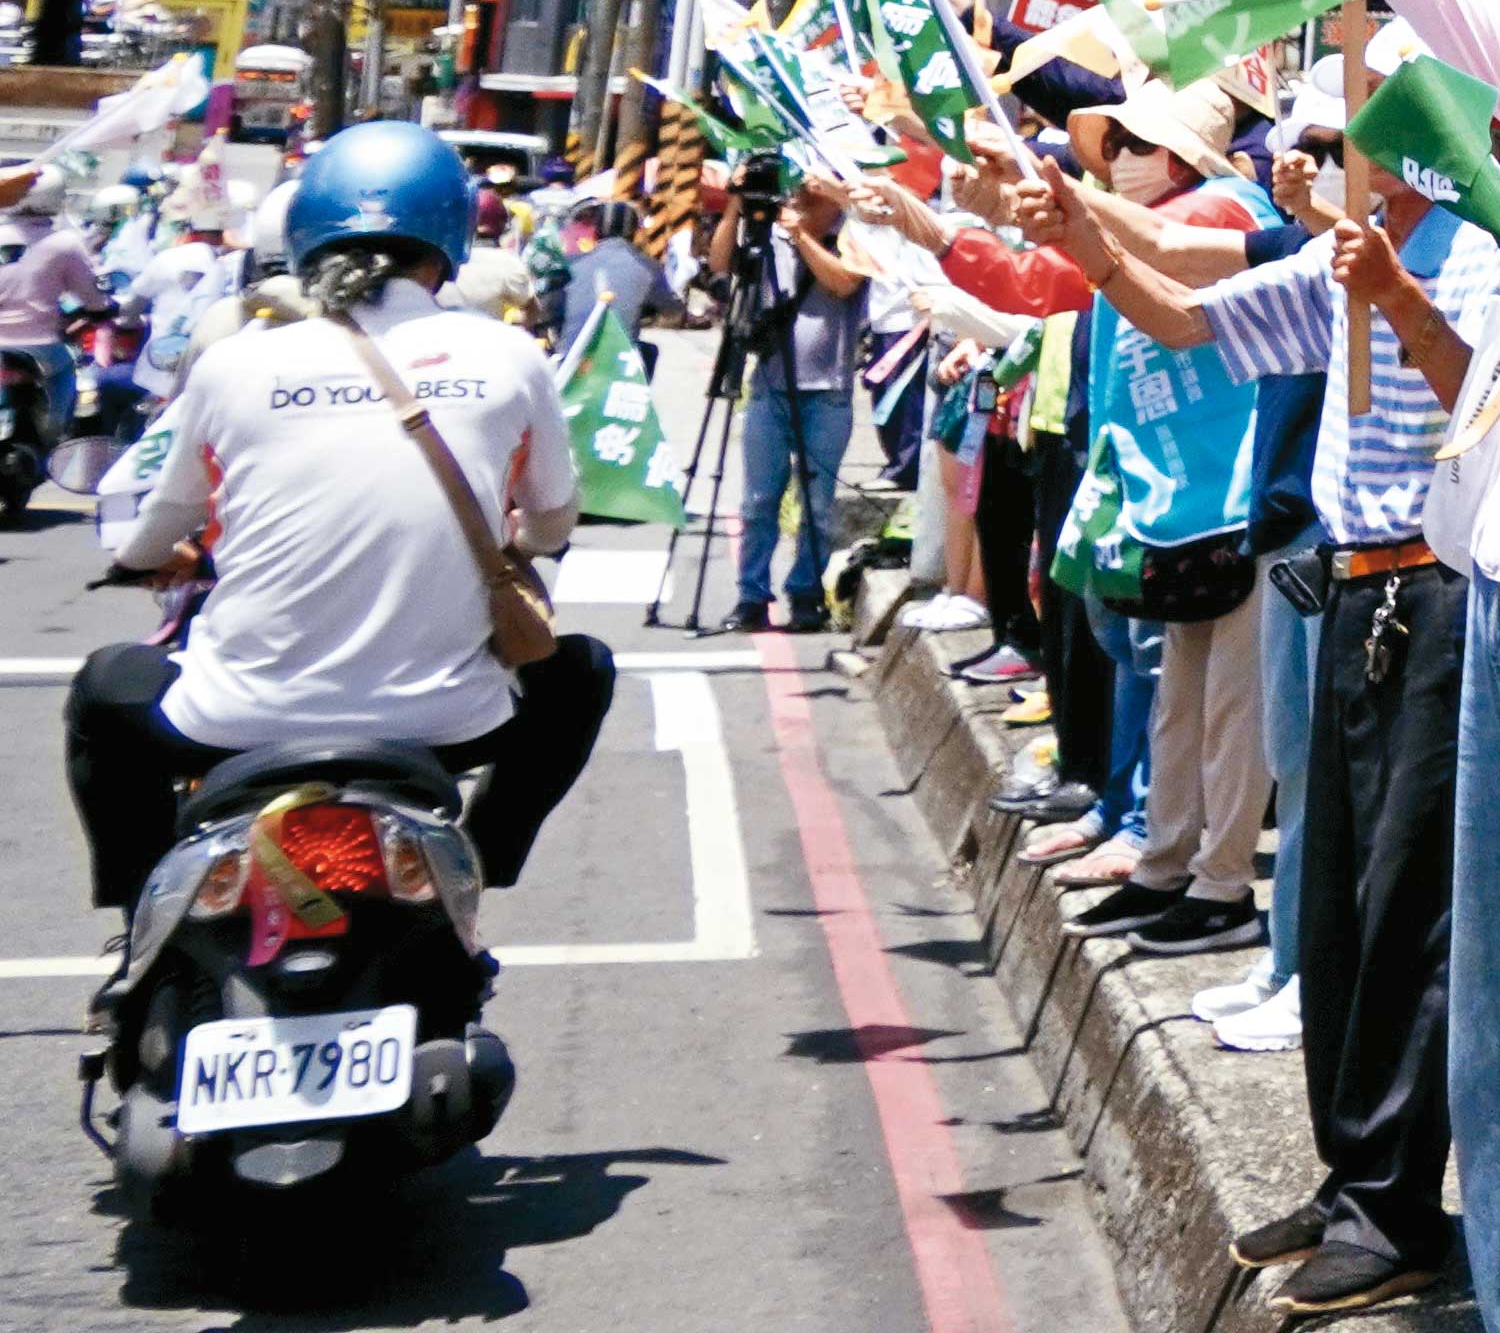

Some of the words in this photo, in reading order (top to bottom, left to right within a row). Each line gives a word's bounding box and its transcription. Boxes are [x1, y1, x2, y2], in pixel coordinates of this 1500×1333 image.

[270, 385, 316, 411] DO
[415, 378, 487, 400] BEST
[191, 1037, 401, 1107] NKR-7980
